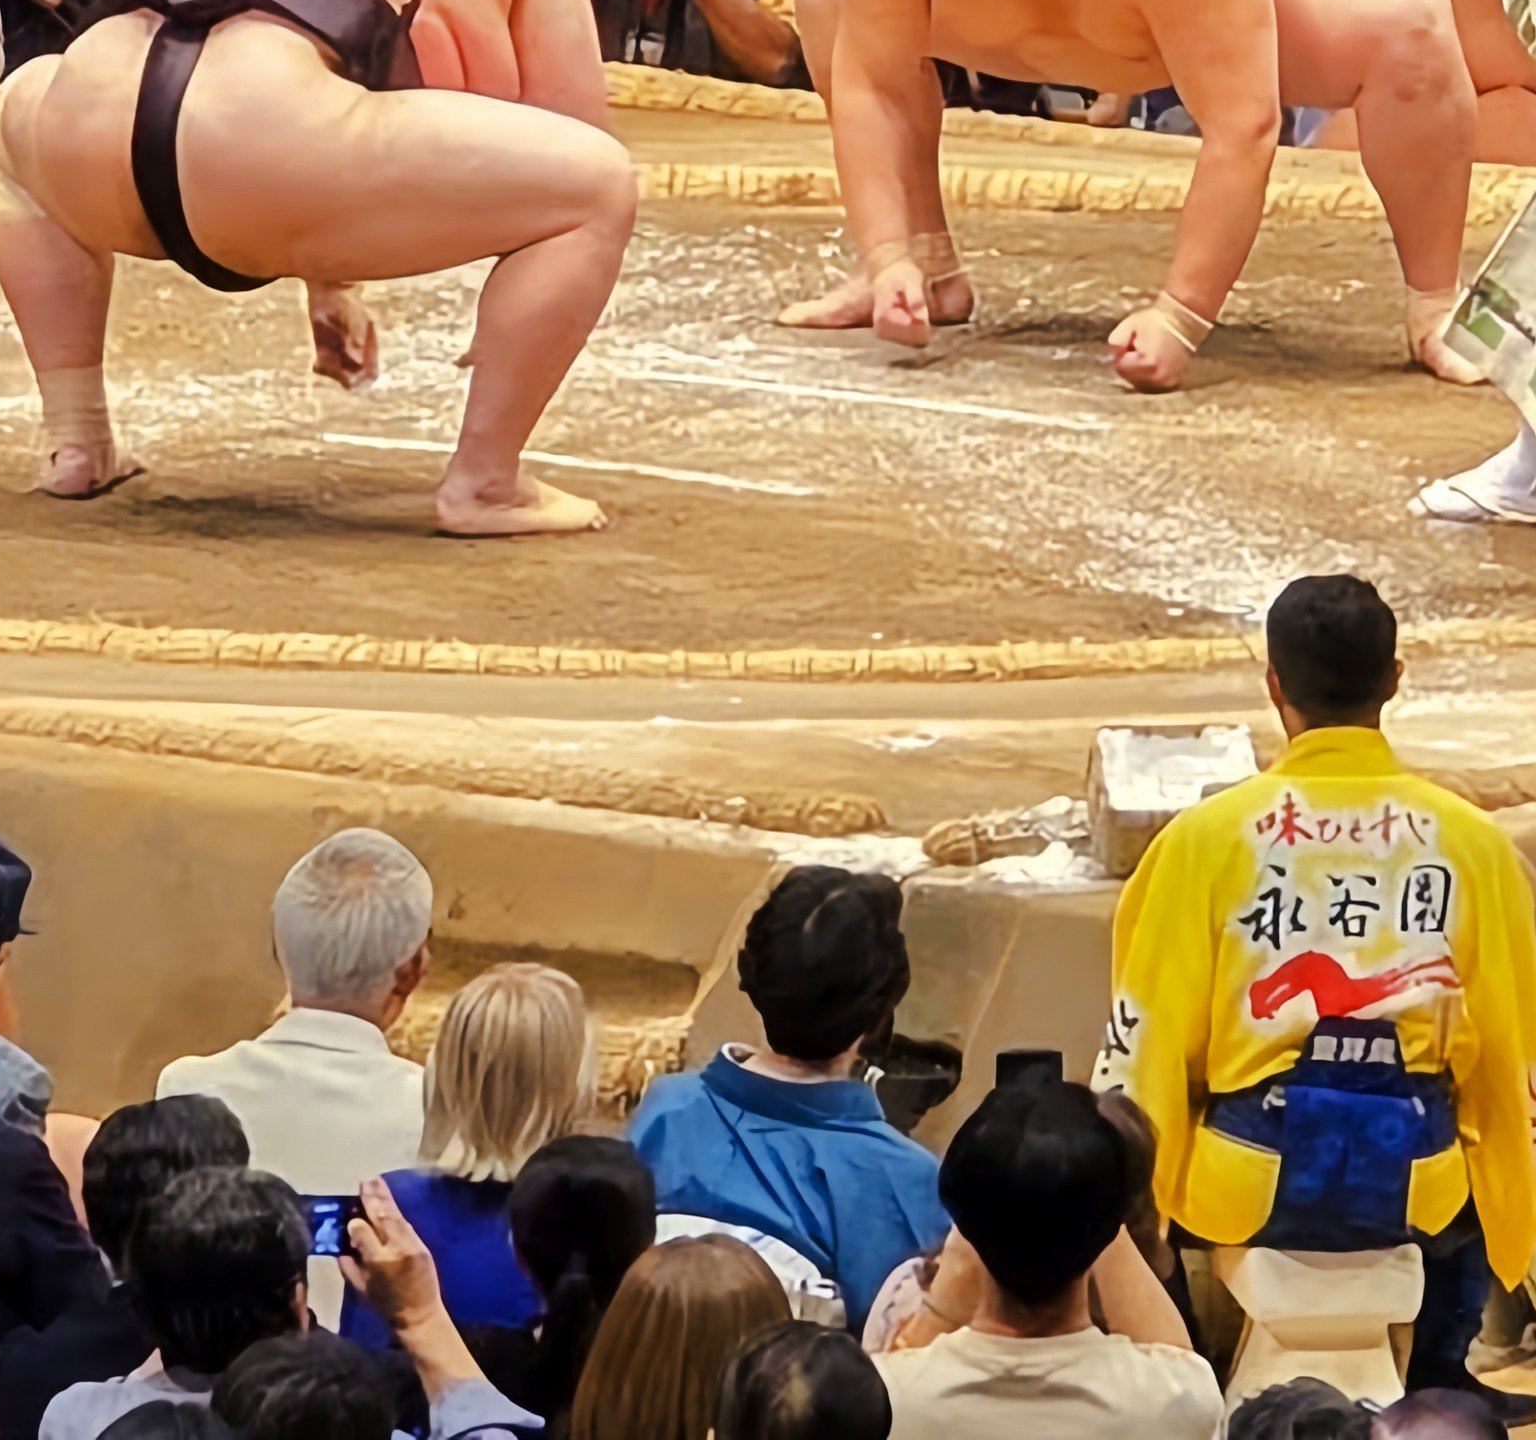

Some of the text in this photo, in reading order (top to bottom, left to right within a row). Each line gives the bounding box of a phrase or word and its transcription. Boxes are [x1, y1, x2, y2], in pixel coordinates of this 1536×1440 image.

[1255, 792, 1431, 847] 味ひとすじ
[1239, 864, 1452, 950] 永谷園
